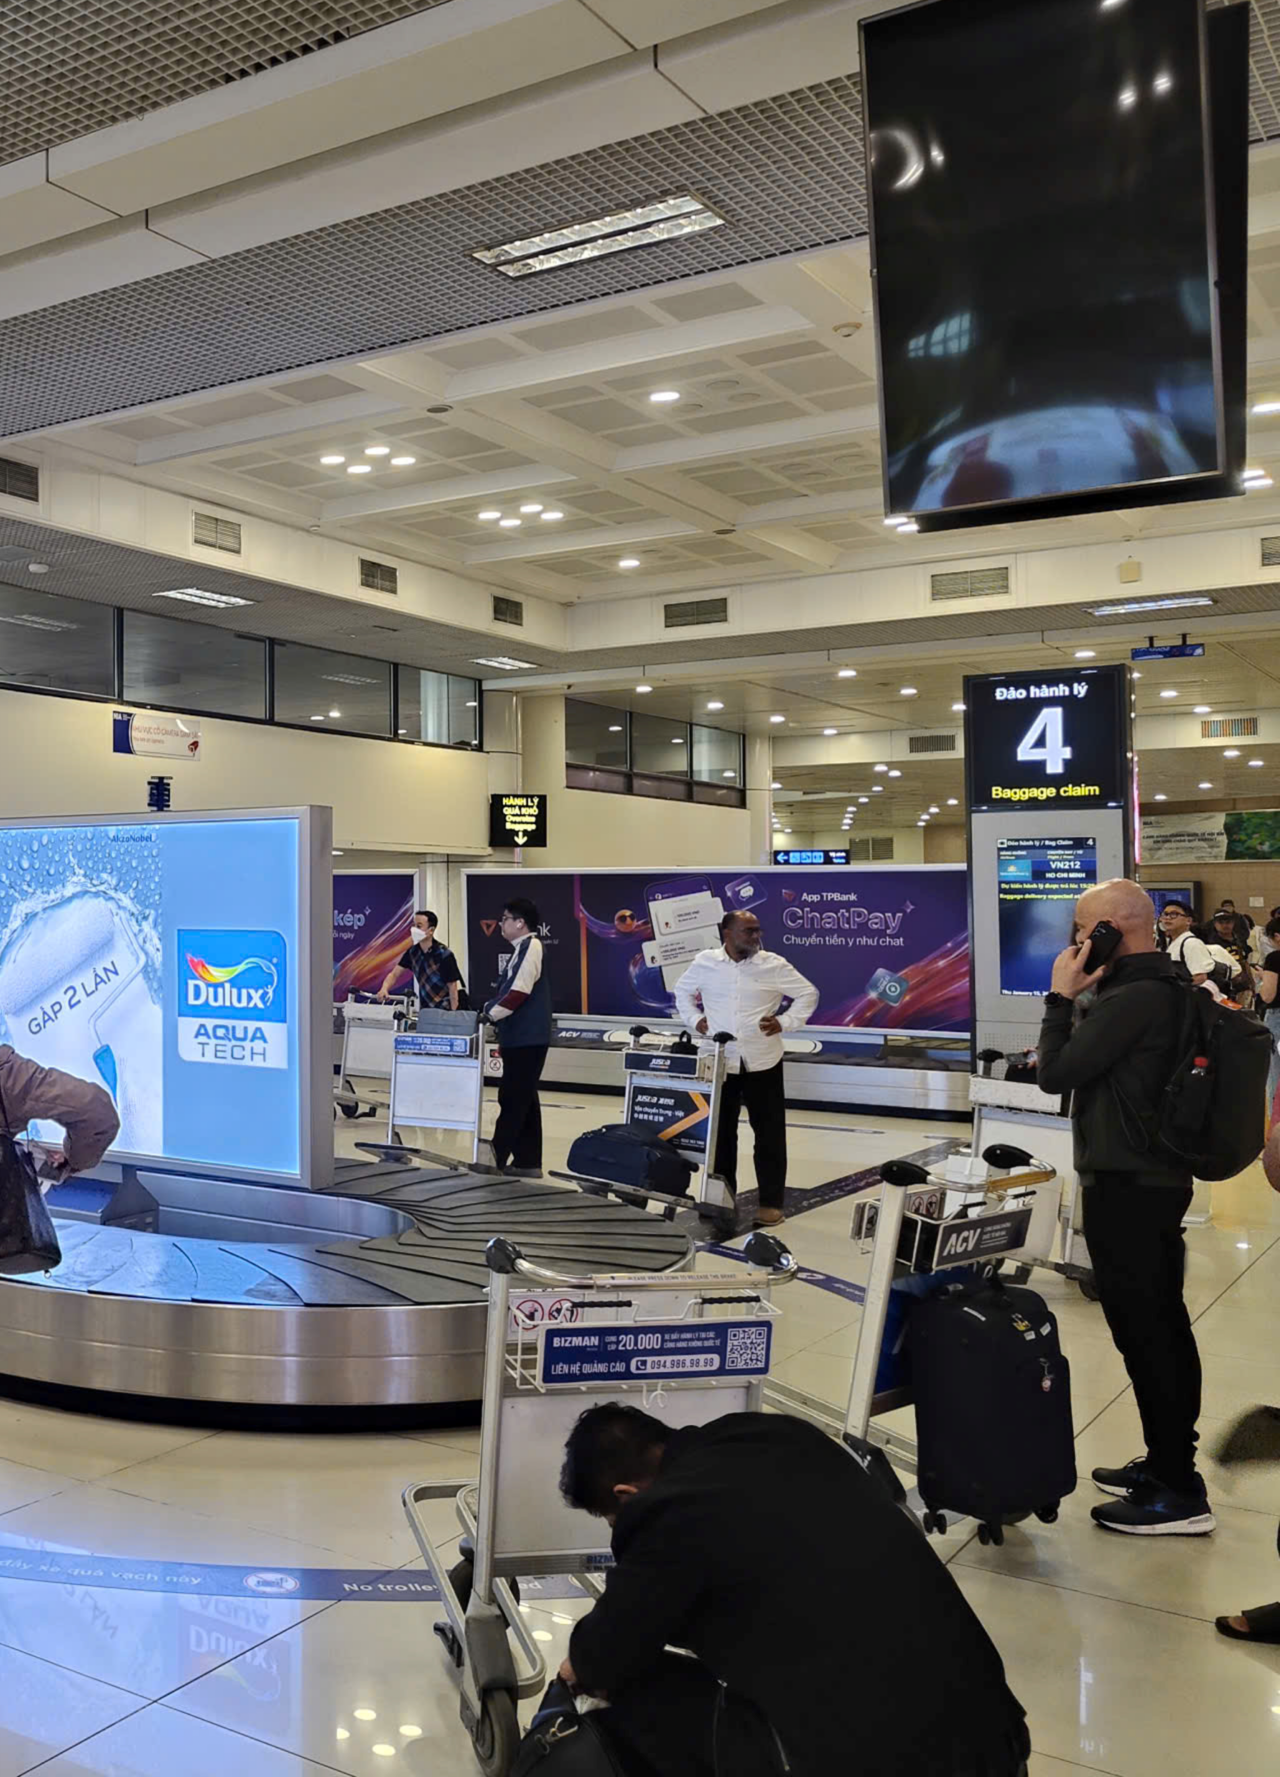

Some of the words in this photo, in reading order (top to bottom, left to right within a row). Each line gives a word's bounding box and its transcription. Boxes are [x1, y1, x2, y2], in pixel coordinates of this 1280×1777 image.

[995, 687, 1027, 700] Đảo
[1030, 683, 1069, 698] hành
[1073, 682, 1089, 698] lý
[1017, 707, 1072, 774] 4
[992, 786, 1057, 800] Baggage
[1060, 784, 1100, 796] claim
[1050, 860, 1081, 869] VN212
[801, 892, 821, 902] App
[822, 892, 858, 901] TPBank
[333, 908, 366, 929] kép
[782, 907, 904, 934] ChatPay
[847, 936, 854, 947] y
[879, 936, 905, 946] chat
[63, 985, 81, 1009] 2
[186, 978, 265, 1009] Dulux
[194, 1023, 269, 1044] AQUA
[197, 1042, 267, 1062] TECH
[942, 1228, 981, 1257] ACV
[553, 1336, 599, 1348] BIZMAN
[618, 1333, 661, 1351] 20.000
[551, 1362, 570, 1375] LIÊN
[570, 1362, 581, 1376] HỆ
[582, 1361, 608, 1374] QUẢNG
[609, 1360, 626, 1373] CÁO
[650, 1357, 715, 1370] 094.986.98.98
[343, 1582, 363, 1592] No
